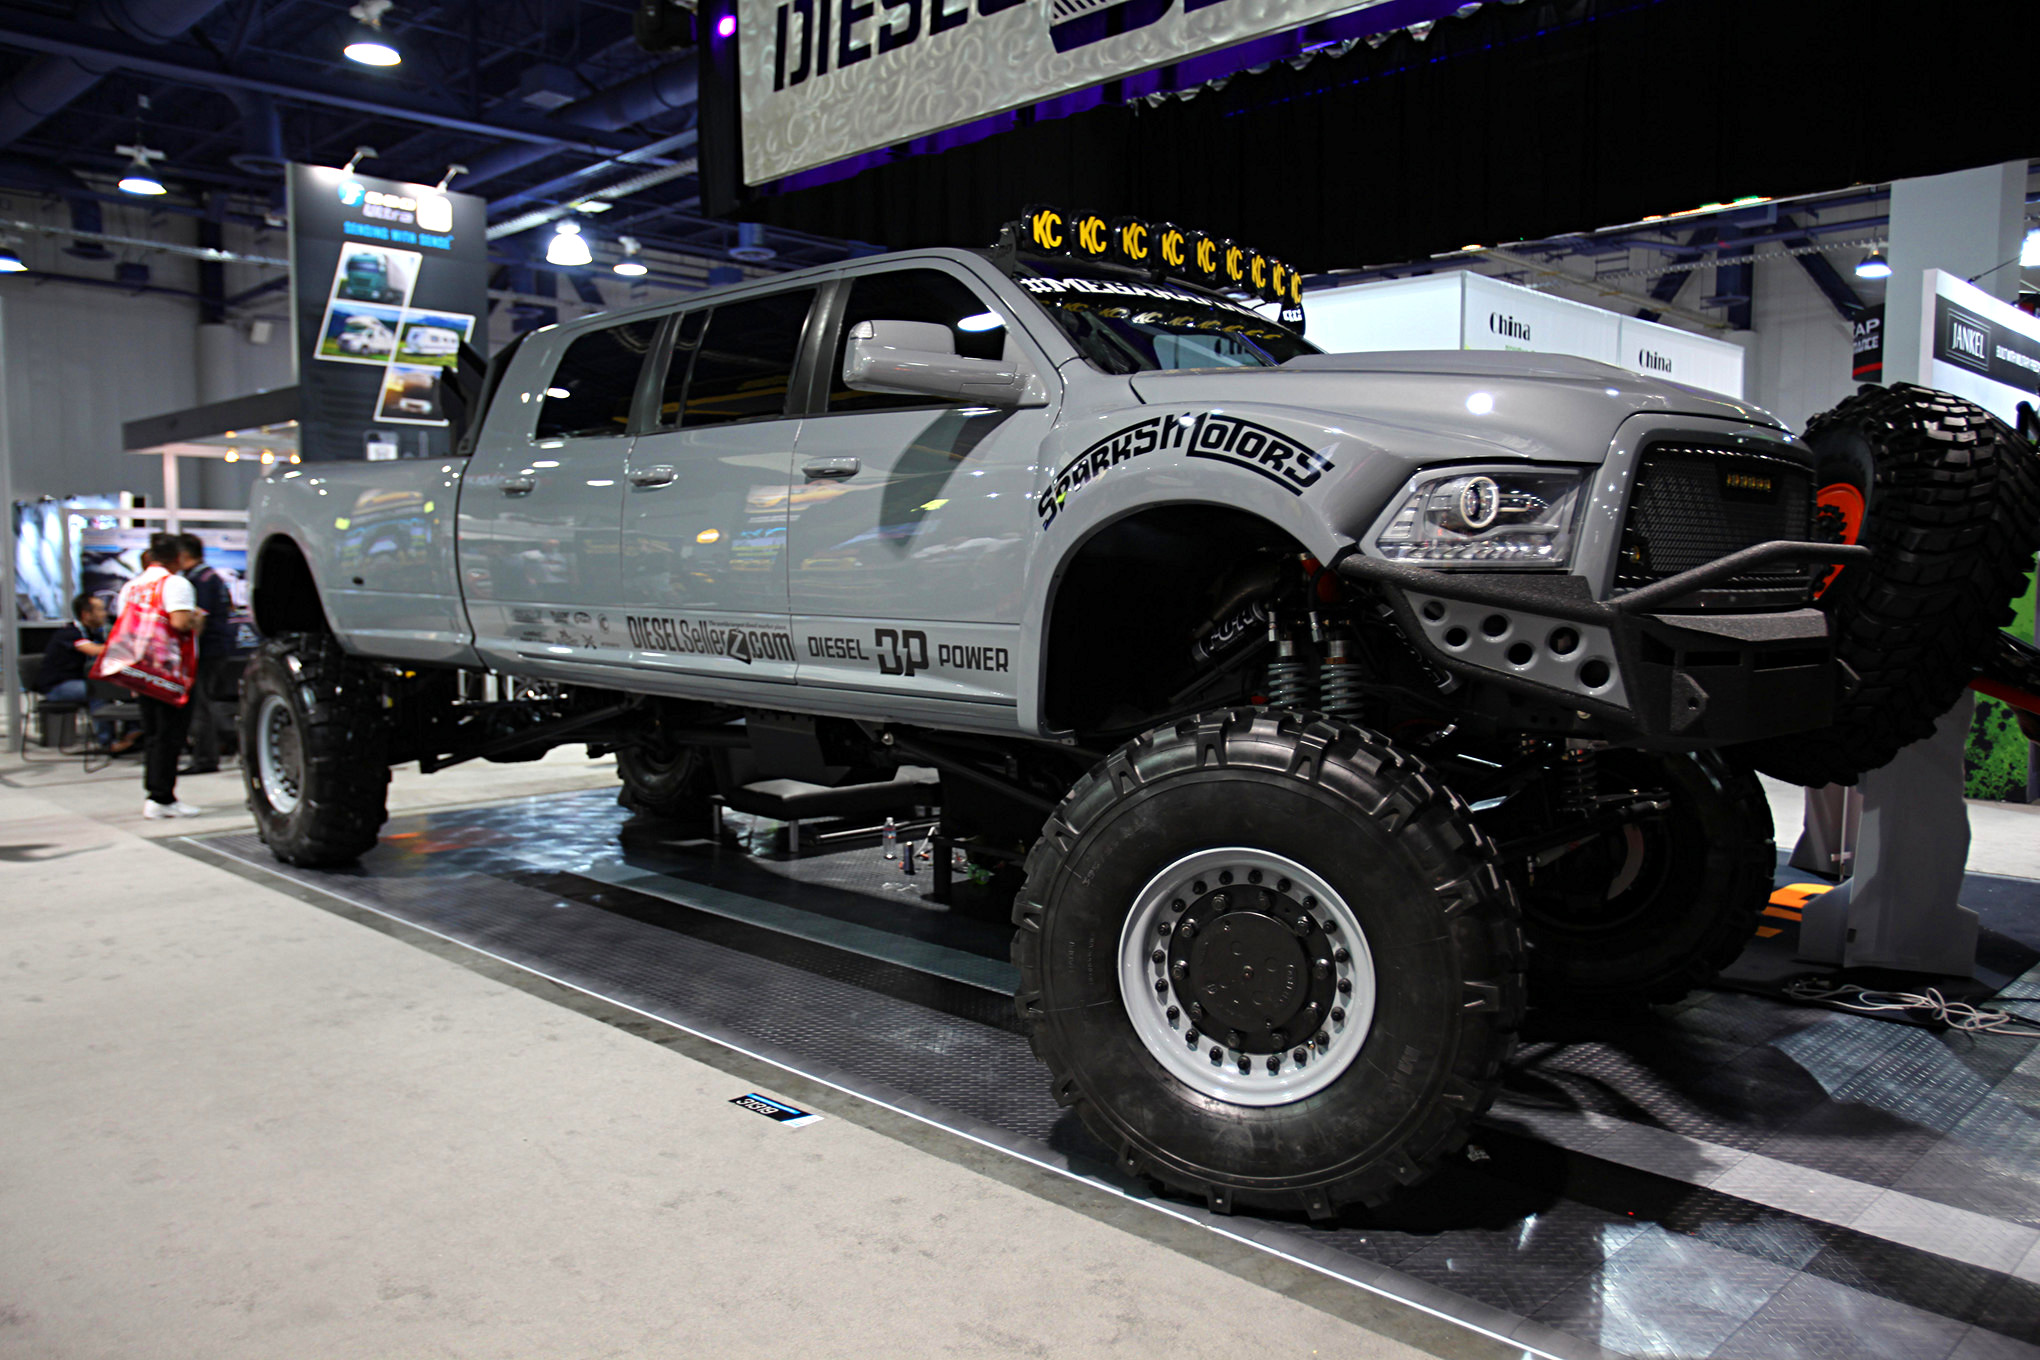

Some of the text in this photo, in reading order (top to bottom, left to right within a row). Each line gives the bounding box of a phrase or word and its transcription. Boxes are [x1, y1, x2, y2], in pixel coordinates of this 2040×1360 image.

[773, 0, 1027, 92] DIES
[1033, 210, 1062, 249] KC
[1079, 216, 1107, 254] KC
[1122, 222, 1148, 260] KC
[1161, 229, 1185, 266] KC
[1197, 237, 1217, 273] KC
[1226, 246, 1244, 281] KC
[1251, 255, 1266, 289] KC
[1273, 263, 1286, 296] KC
[1291, 271, 1302, 304] KC
[1489, 311, 1531, 342] China
[1952, 322, 1986, 359] JANKEL
[1638, 348, 1672, 374] China
[807, 636, 870, 661] DIESEL
[938, 643, 1009, 673] POWER
